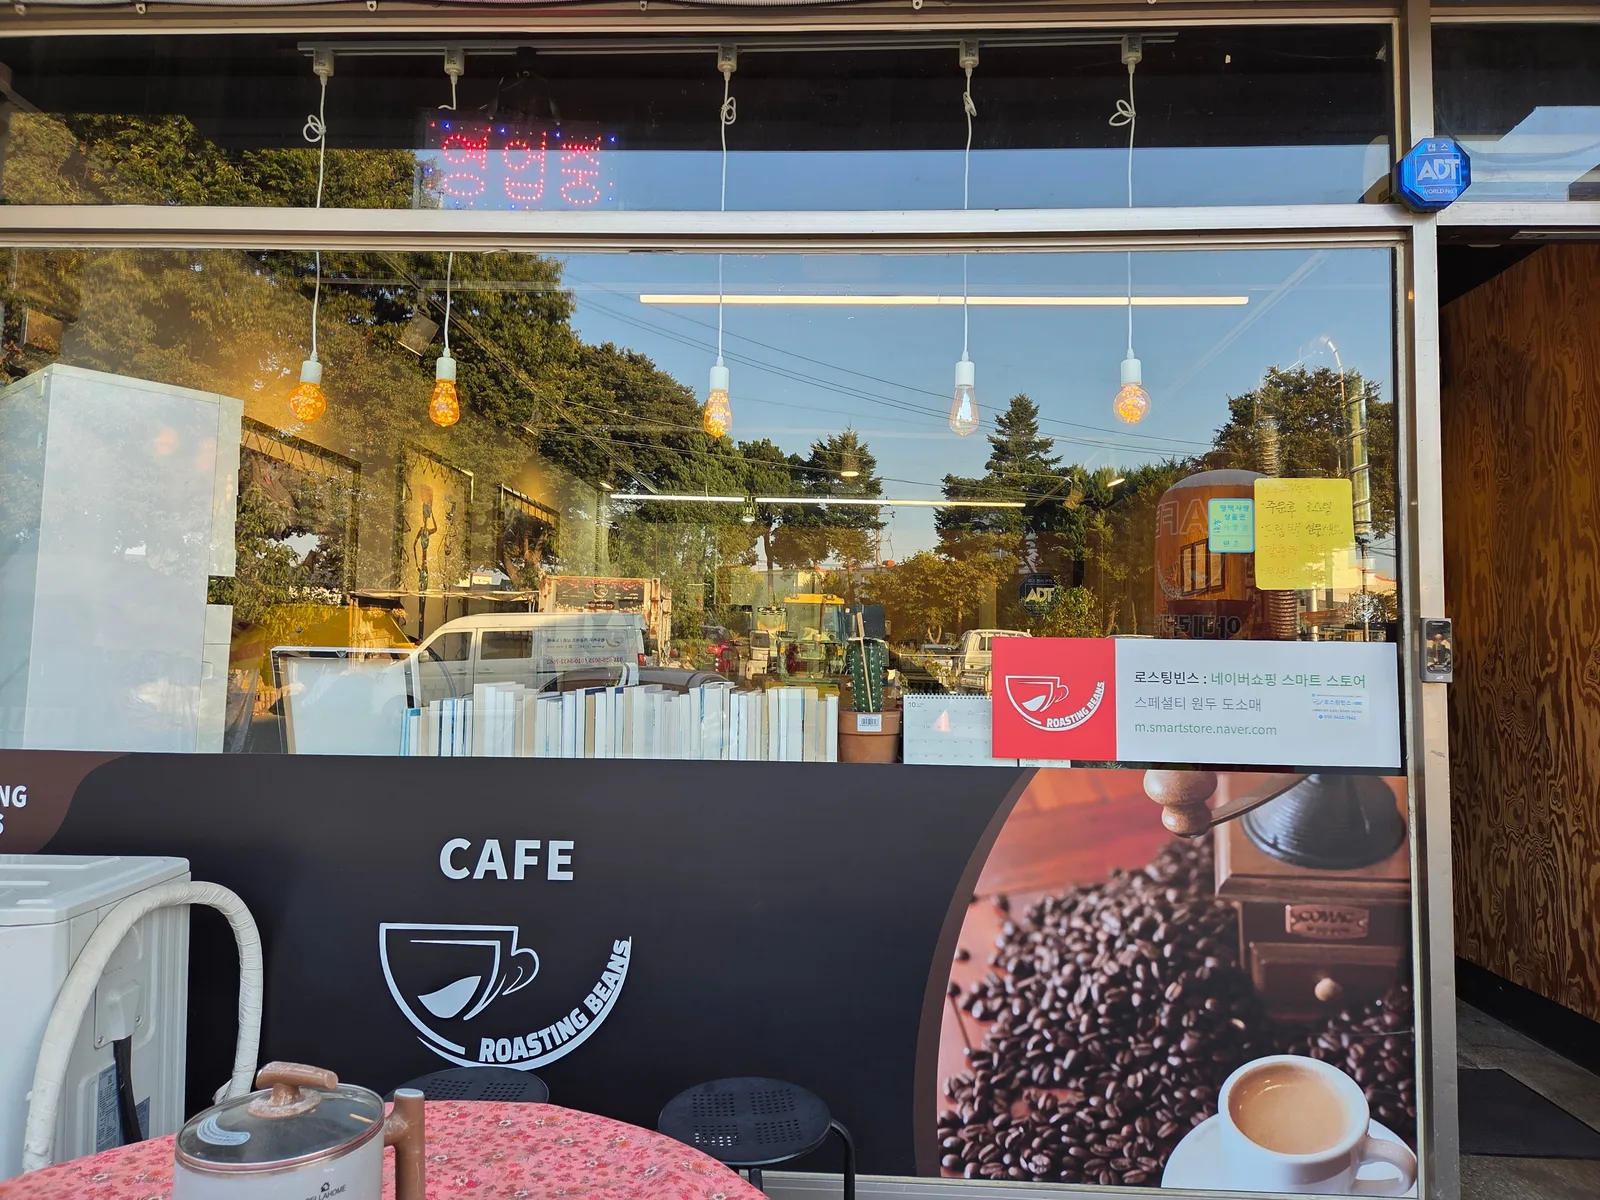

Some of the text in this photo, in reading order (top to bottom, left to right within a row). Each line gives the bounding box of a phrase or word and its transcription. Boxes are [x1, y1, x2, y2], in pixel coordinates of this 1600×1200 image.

[442, 128, 602, 204] 영업중
[1417, 159, 1460, 181] ADT
[1025, 587, 1055, 603] ADT
[1134, 671, 1200, 685] 로스팅빈스
[1211, 672, 1277, 687] 네이버쇼핑
[1281, 673, 1322, 688] 스마트
[1326, 674, 1366, 688] 스토어
[1046, 681, 1105, 728] ROASTING BEANS
[1134, 696, 1262, 712] 스페셜티 원두 도소매
[1134, 723, 1277, 736] m.smartstore.naver.com
[439, 837, 575, 881] CAFE
[478, 939, 631, 1063] ROASTING BEANS
